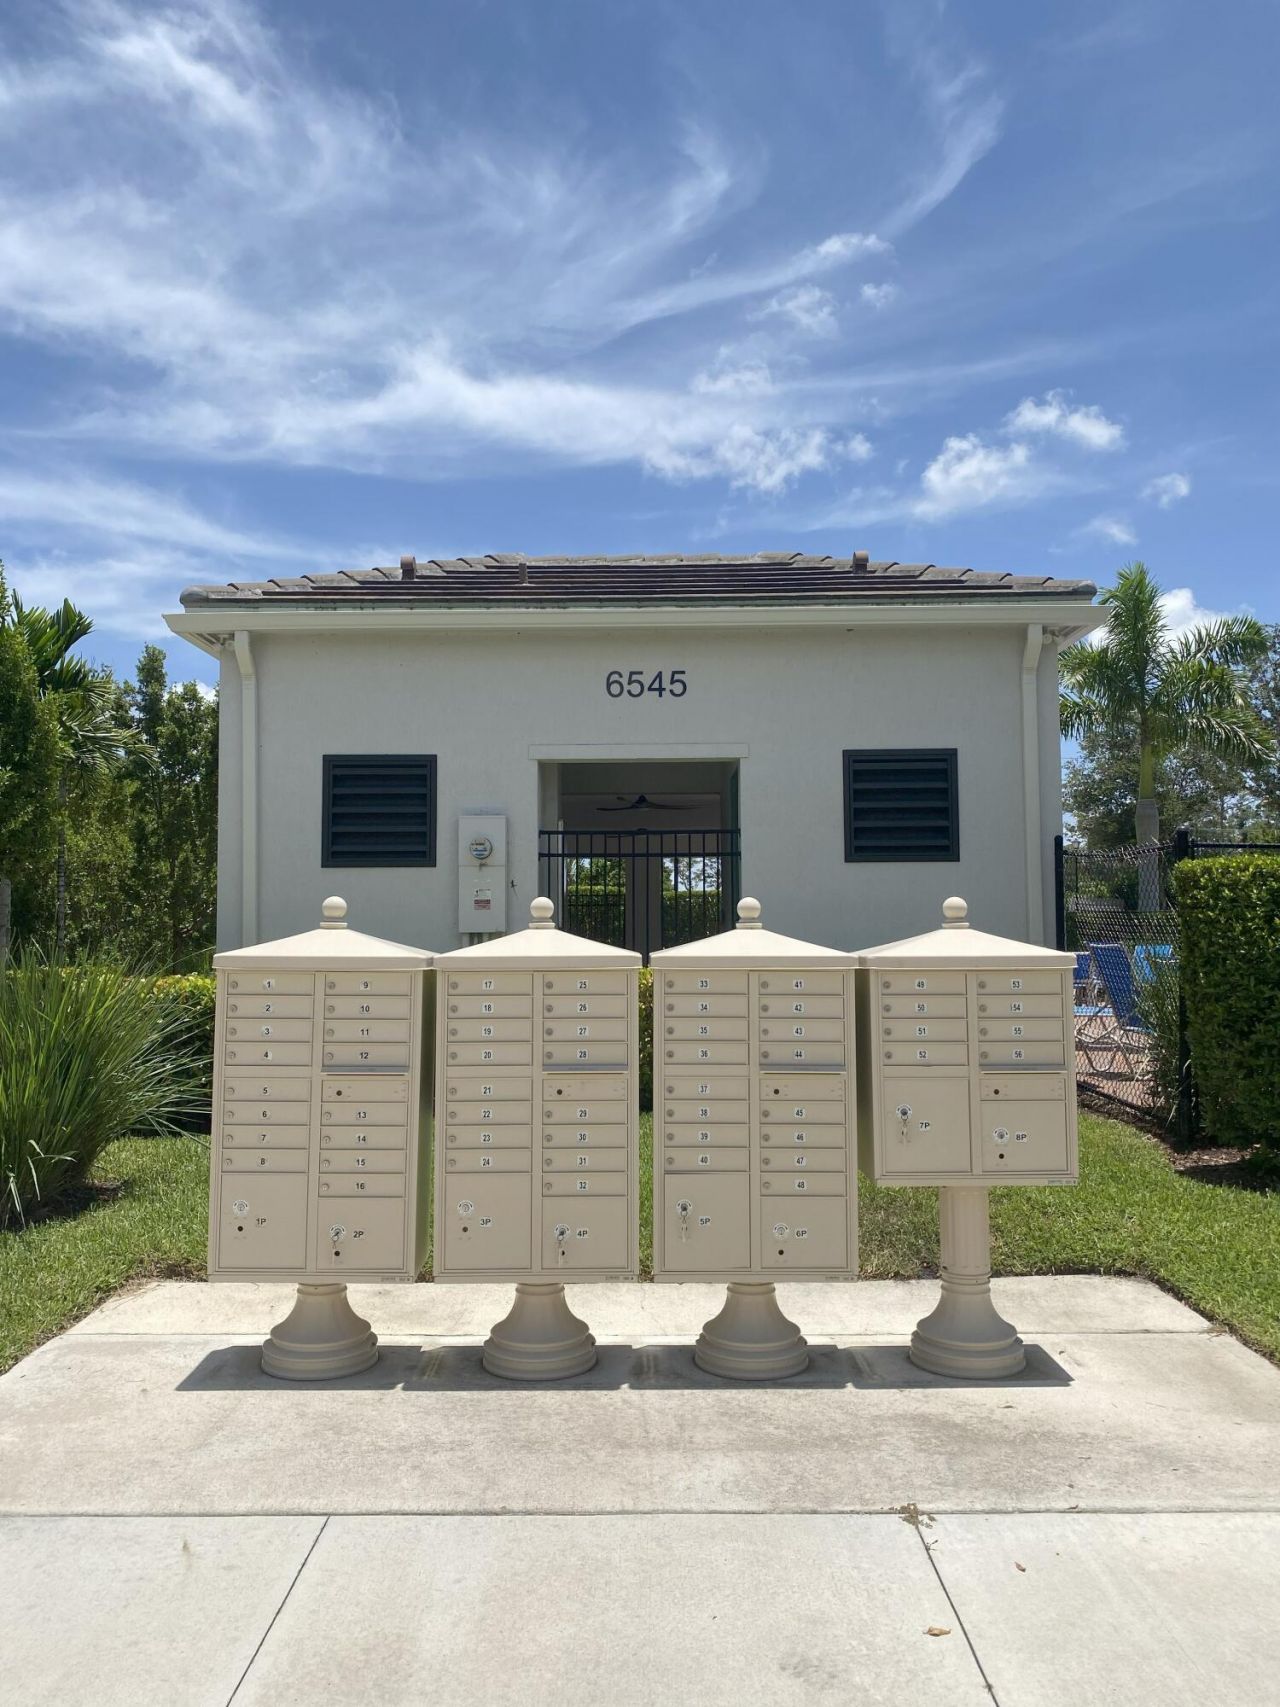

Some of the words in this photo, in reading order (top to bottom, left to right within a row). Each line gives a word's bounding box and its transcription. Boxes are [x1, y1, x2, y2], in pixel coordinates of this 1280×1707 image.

[605, 670, 688, 698] 6545
[484, 981, 492, 989] 17
[579, 981, 587, 989] 25
[700, 980, 708, 988] 33
[1012, 980, 1020, 989] 53
[360, 1005, 370, 1013] 10
[484, 1004, 492, 1012] 18
[579, 1003, 587, 1012] 26
[700, 1003, 708, 1011] 34
[794, 1004, 802, 1012] 42
[917, 1004, 925, 1012] 50
[360, 1028, 369, 1036] 11
[483, 1027, 492, 1036] 19
[579, 1027, 587, 1035] 27
[700, 1026, 708, 1034] 35
[795, 1027, 802, 1035] 43
[918, 1027, 926, 1035] 51
[1014, 1027, 1022, 1035] 55
[360, 1052, 369, 1060] 12
[484, 1051, 492, 1059] 20
[579, 1050, 587, 1059] 28
[700, 1049, 708, 1058] 36
[919, 1050, 927, 1059] 52
[1014, 1050, 1022, 1058] 56
[483, 1086, 491, 1095] 21
[700, 1085, 708, 1093] 37
[358, 1111, 367, 1119] 13
[483, 1110, 491, 1118] 22
[579, 1109, 587, 1118] 29
[700, 1108, 707, 1117] 38
[795, 1109, 803, 1117] 45
[483, 1134, 491, 1142] 23
[579, 1133, 587, 1141] 30
[700, 1132, 708, 1141] 39
[796, 1133, 804, 1141] 46
[1015, 1133, 1027, 1141] 8P
[356, 1158, 366, 1166] 15
[482, 1158, 490, 1167] 24
[579, 1157, 586, 1165] 31
[700, 1156, 708, 1164] 40
[796, 1156, 804, 1165] 47
[356, 1182, 365, 1190] 16
[579, 1181, 587, 1189] 32
[797, 1181, 805, 1189] 48
[480, 1218, 491, 1226] 3P
[700, 1217, 711, 1225] 5P
[353, 1230, 364, 1238] 2P
